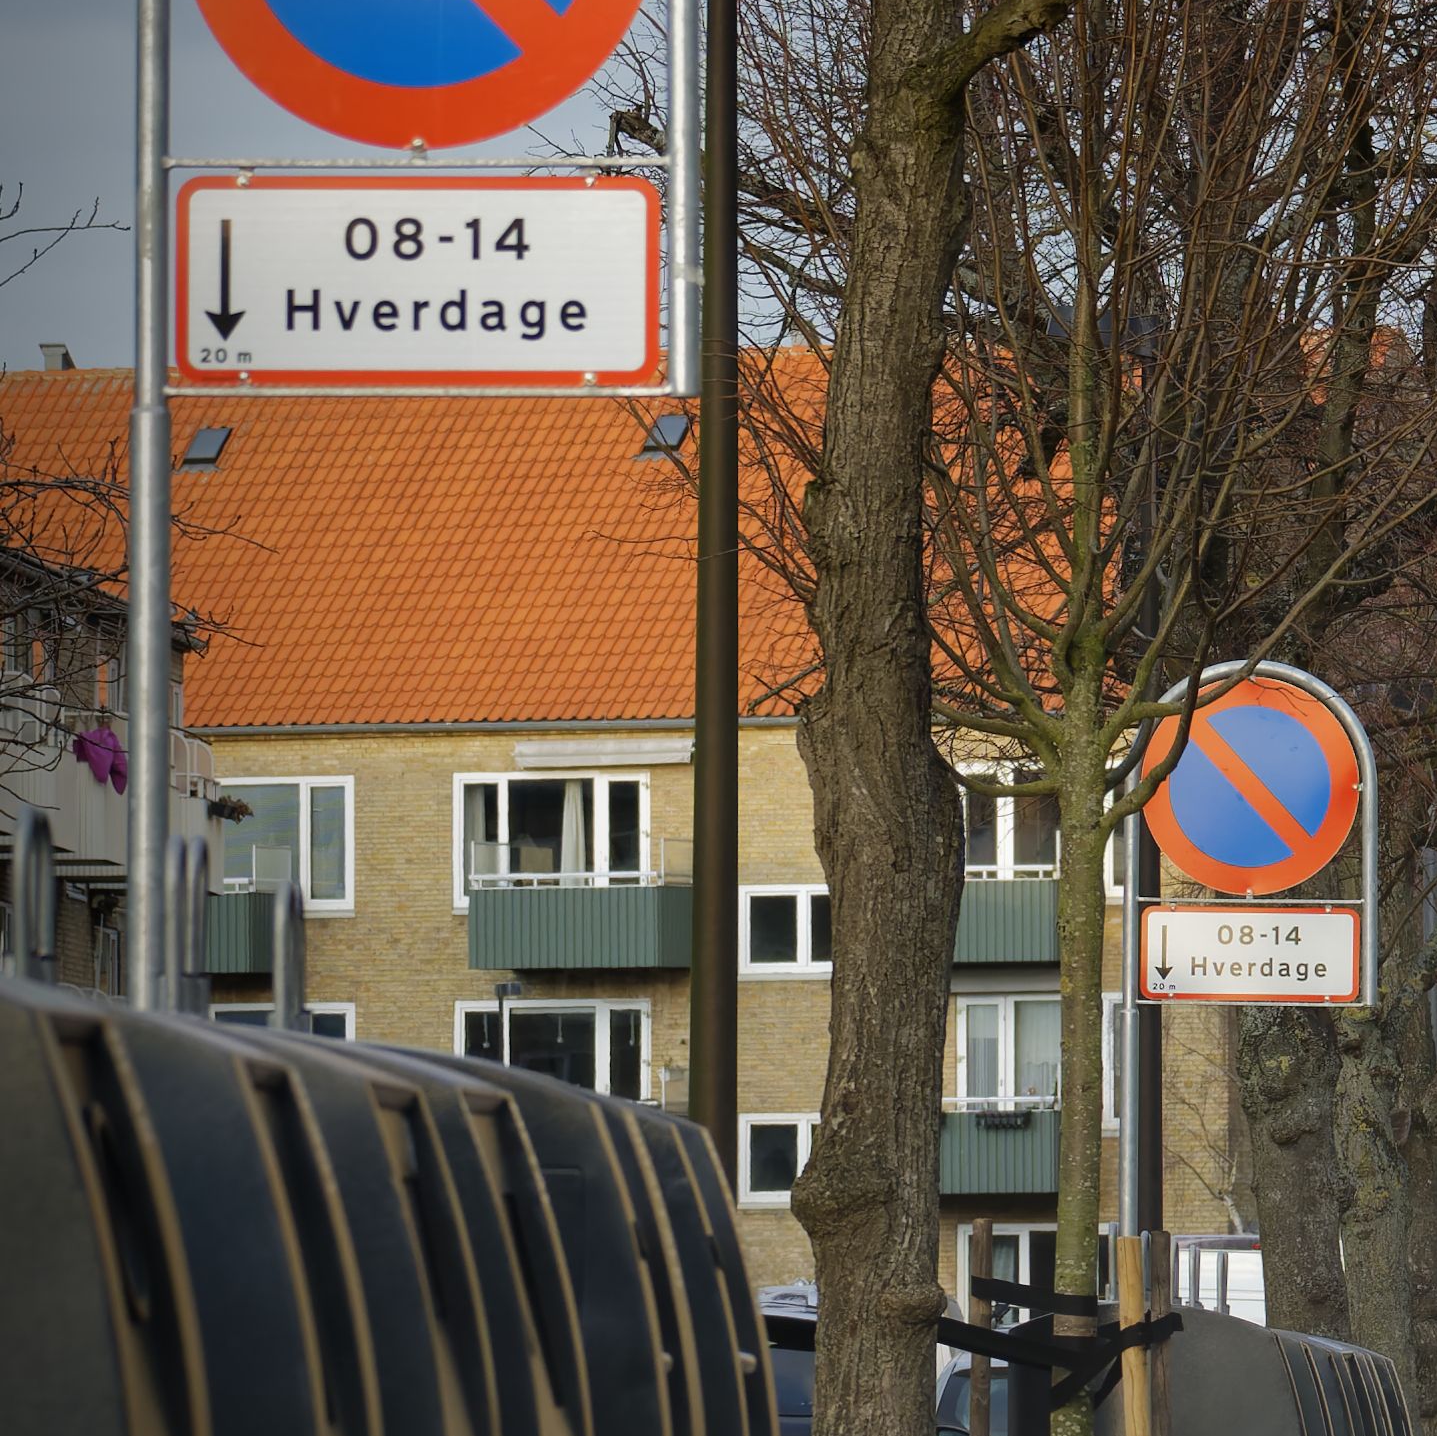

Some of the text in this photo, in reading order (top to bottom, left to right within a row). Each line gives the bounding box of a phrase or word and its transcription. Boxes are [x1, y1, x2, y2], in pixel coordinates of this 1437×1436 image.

[344, 217, 531, 261] 08-14
[286, 288, 588, 341] Hverdage
[200, 348, 252, 364] 20 m
[1217, 924, 1302, 946] 08-14
[1190, 956, 1328, 982] Hverdage
[1152, 982, 1165, 991] 20
